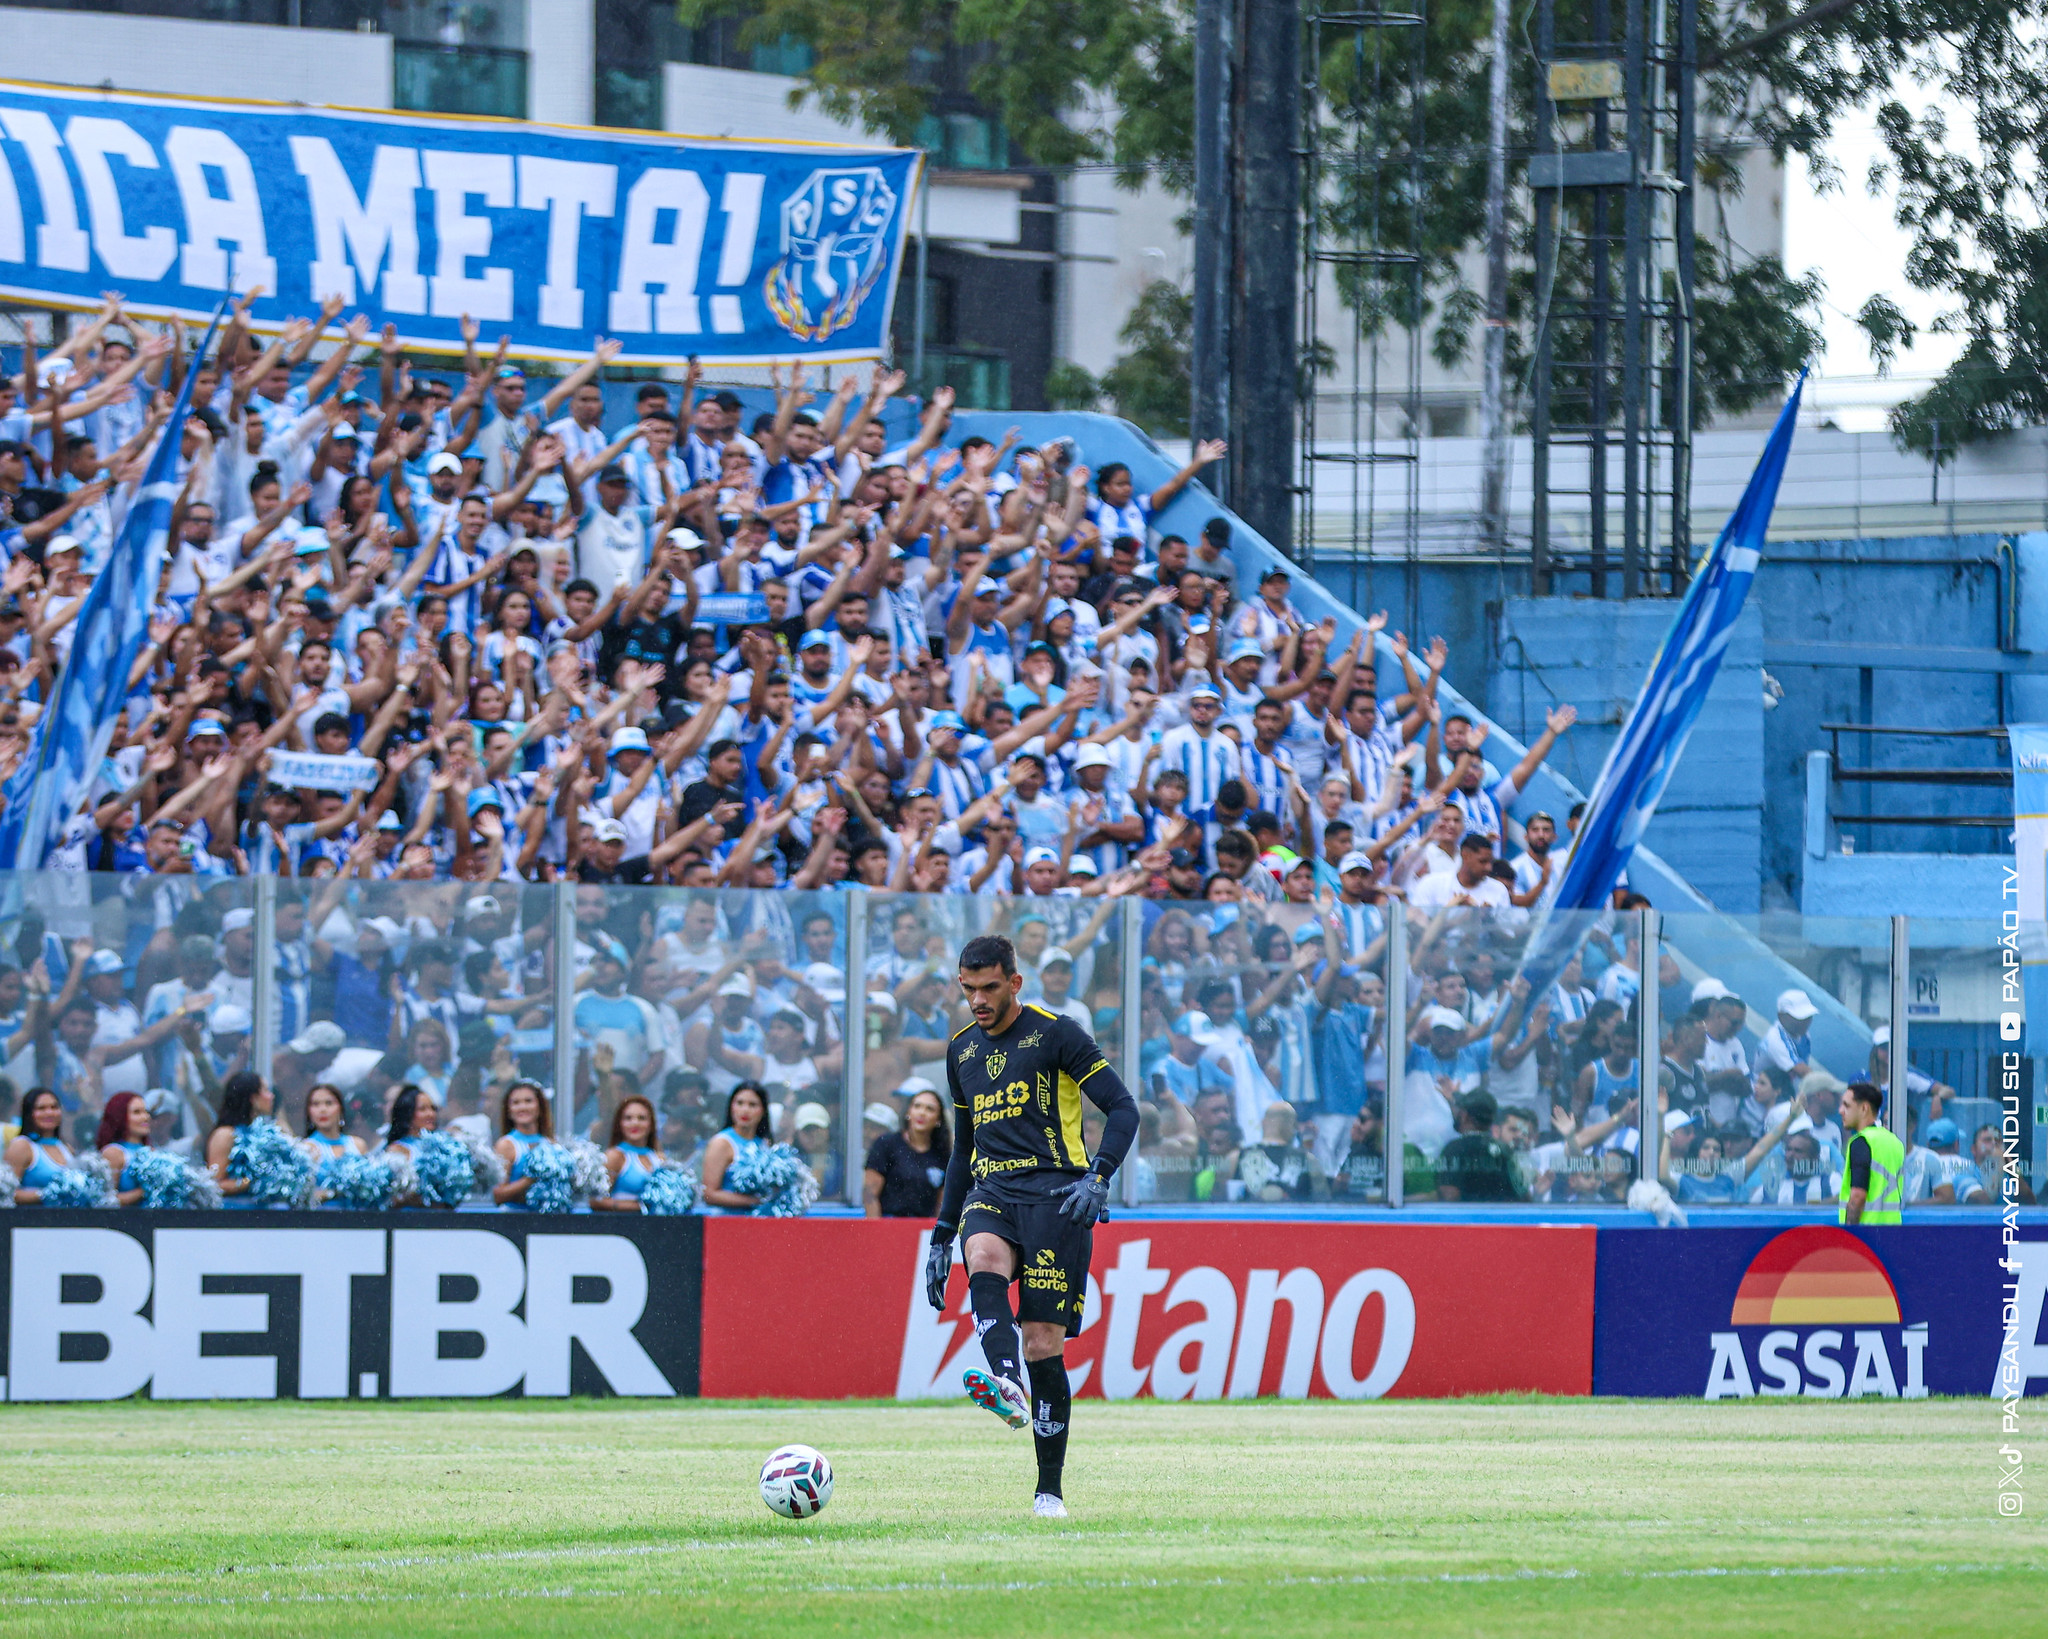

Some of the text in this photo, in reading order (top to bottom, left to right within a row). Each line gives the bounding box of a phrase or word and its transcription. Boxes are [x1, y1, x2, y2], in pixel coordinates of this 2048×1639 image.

[0, 107, 765, 335] ICA META!
[1916, 976, 1938, 1002] P6
[974, 1090, 1004, 1112] Bet
[982, 1106, 1022, 1124] Sorte
[989, 1155, 1038, 1173] Banpará
[1028, 1277, 1068, 1292] sorte
[1704, 1321, 1929, 1400] ASSAÍ
